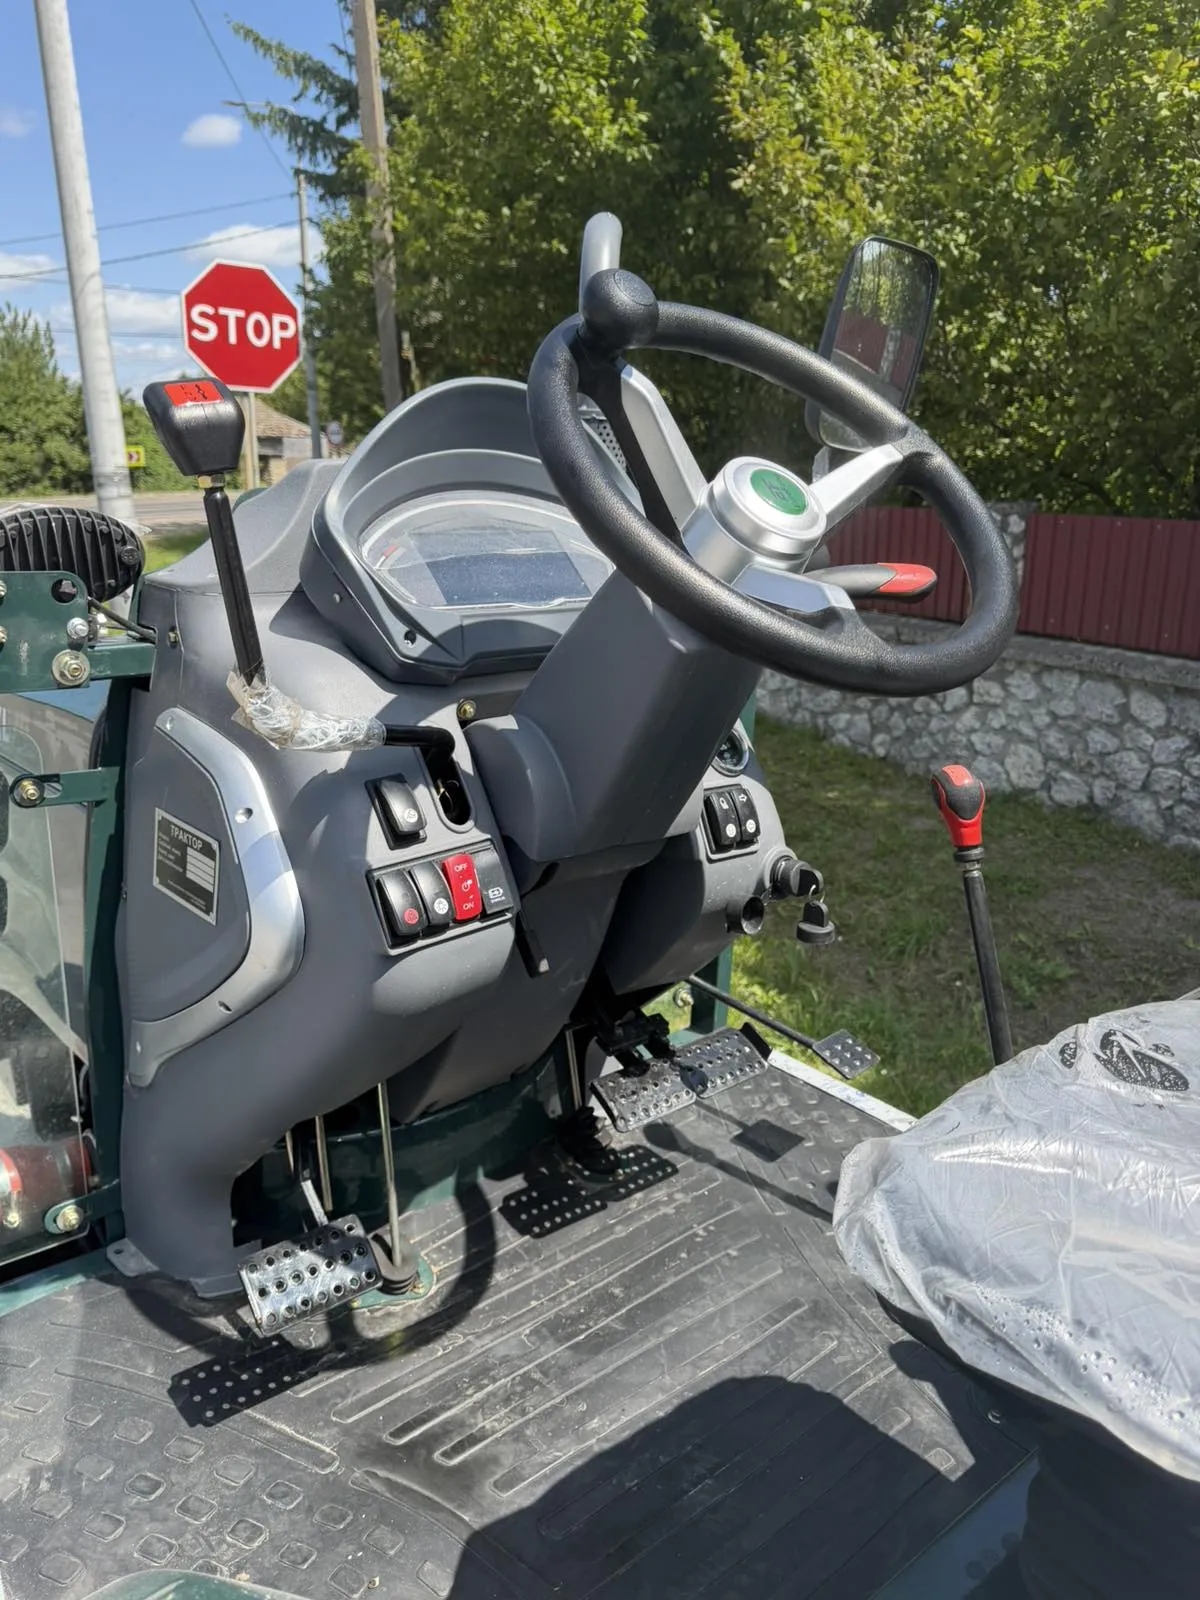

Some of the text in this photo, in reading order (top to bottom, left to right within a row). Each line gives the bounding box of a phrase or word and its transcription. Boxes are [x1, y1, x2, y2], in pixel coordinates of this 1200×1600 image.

[190, 303, 297, 350] STOP
[170, 824, 203, 851] ТРАКТОР
[454, 863, 467, 872] OFF
[463, 901, 475, 910] ON
